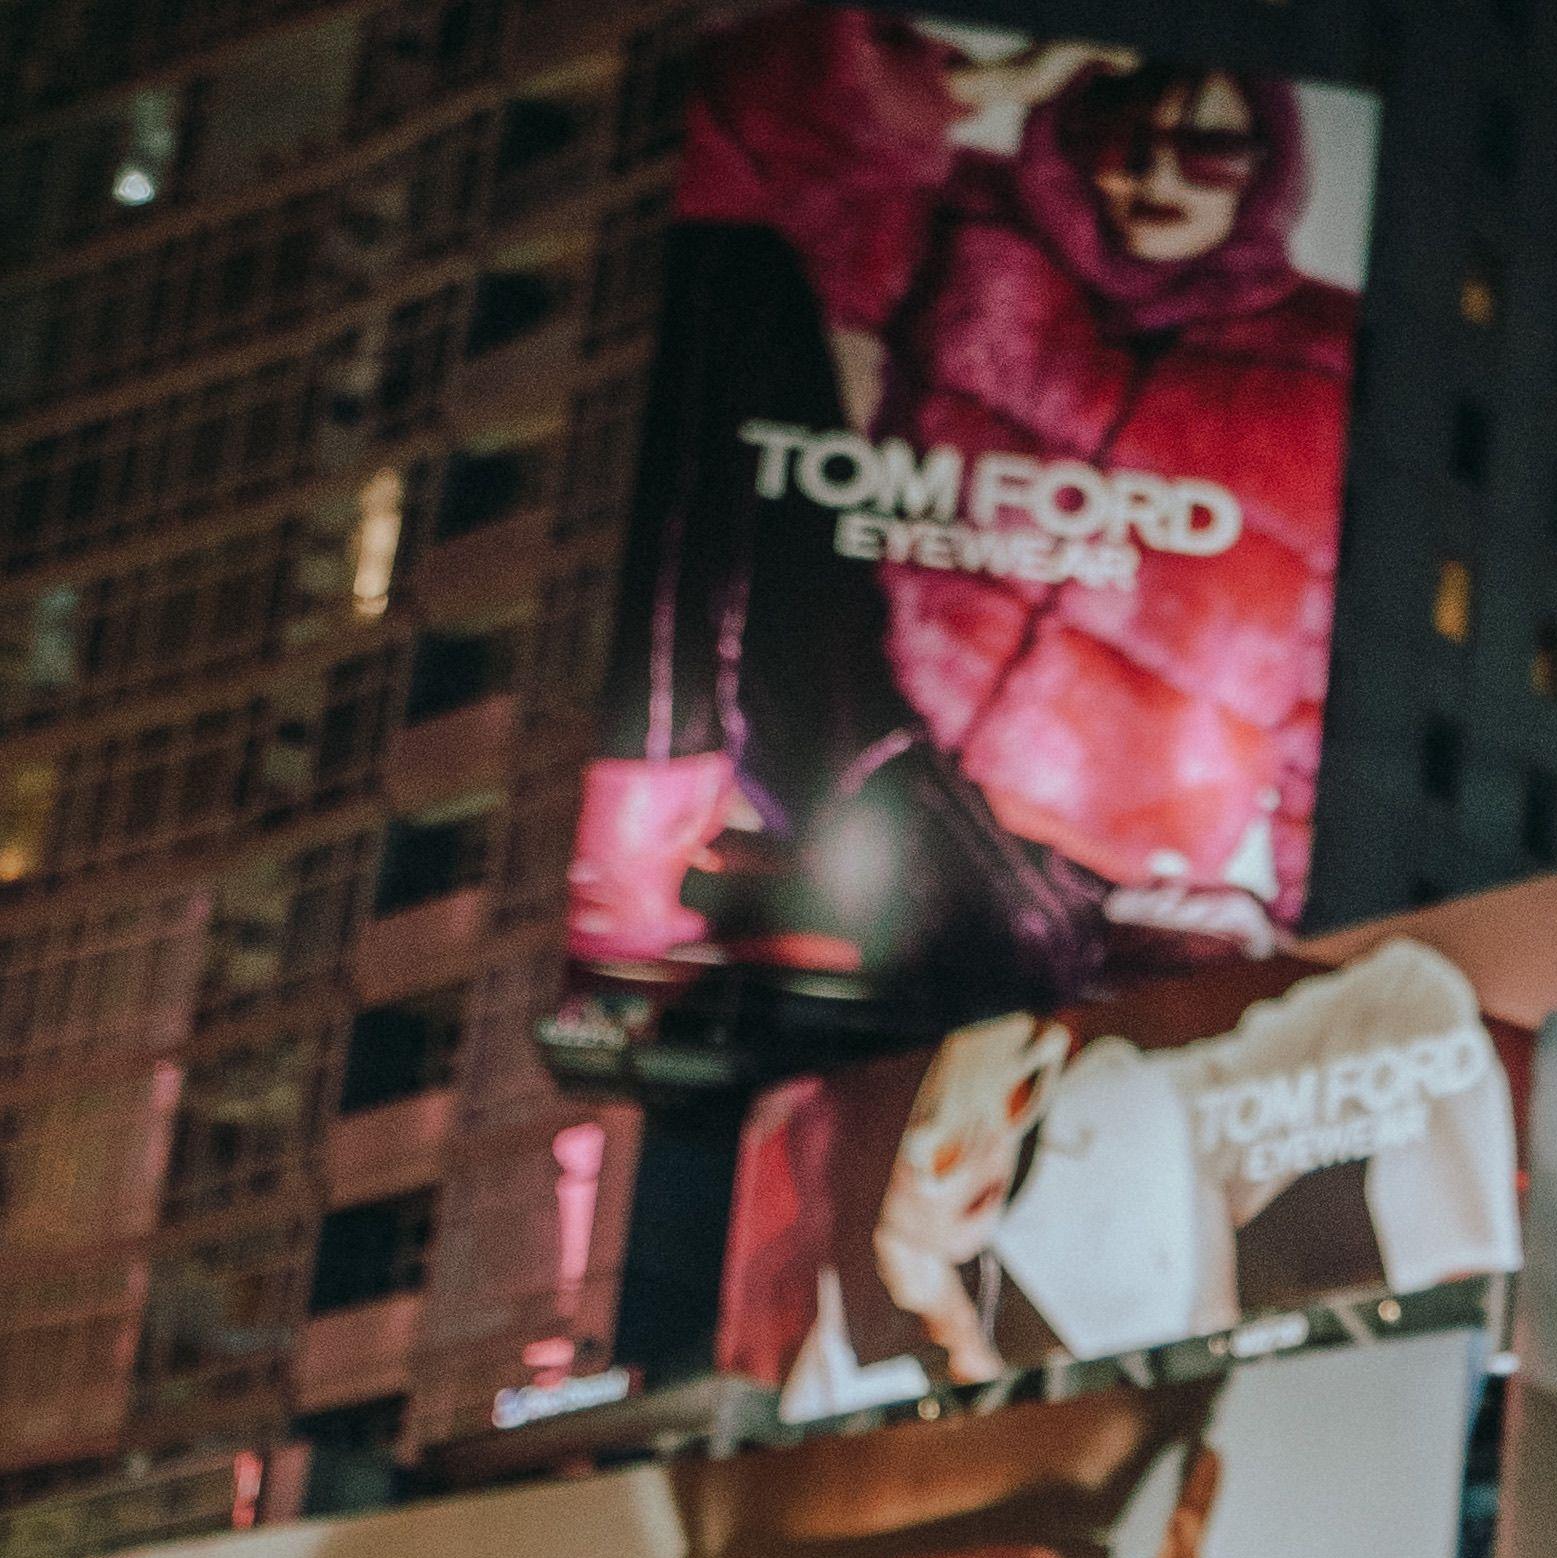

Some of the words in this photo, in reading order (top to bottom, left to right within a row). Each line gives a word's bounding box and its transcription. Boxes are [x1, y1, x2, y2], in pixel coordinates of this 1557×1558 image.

[738, 419, 965, 521] TOM
[969, 452, 1243, 557] FORD
[833, 511, 1142, 591] EYEWEAR
[1194, 1067, 1319, 1151] TOM
[1325, 1028, 1489, 1119] FORD
